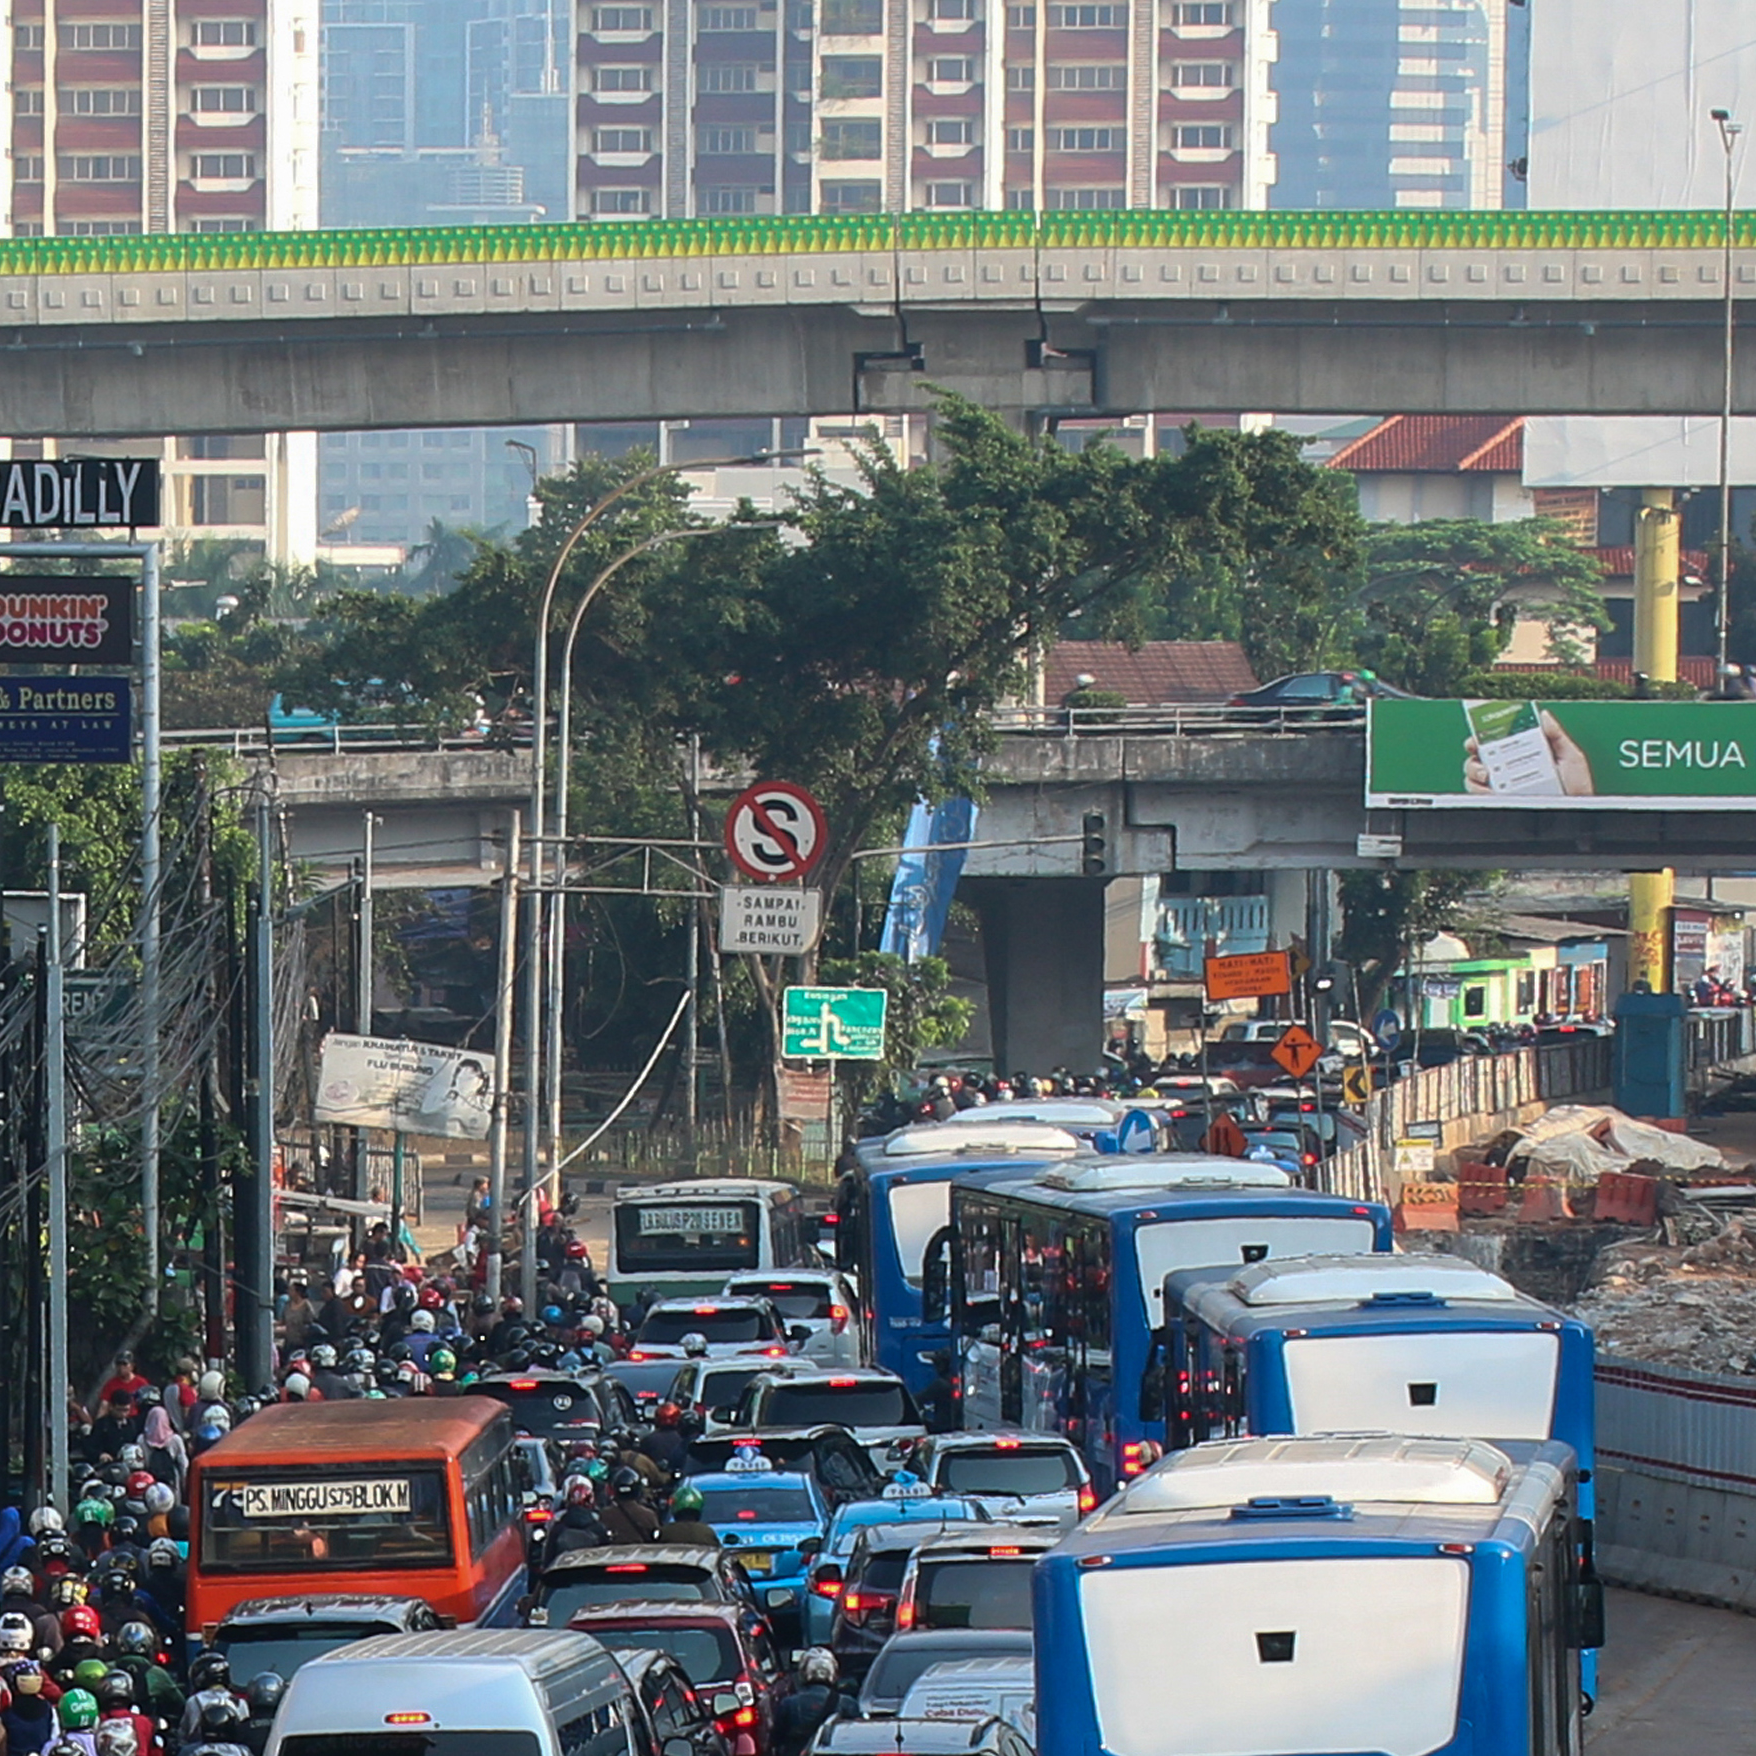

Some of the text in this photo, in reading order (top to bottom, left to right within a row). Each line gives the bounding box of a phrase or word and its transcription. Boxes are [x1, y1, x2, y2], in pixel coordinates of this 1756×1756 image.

[18, 687, 116, 710] Partners
[51, 720, 69, 730] AT
[1619, 740, 1746, 768] SEMUA
[743, 897, 801, 911] SAMPAI
[744, 914, 798, 928] RAMBU
[739, 931, 802, 946] BERIKUT
[271, 1486, 327, 1511] MINGGU
[353, 1484, 395, 1508] BLOK
